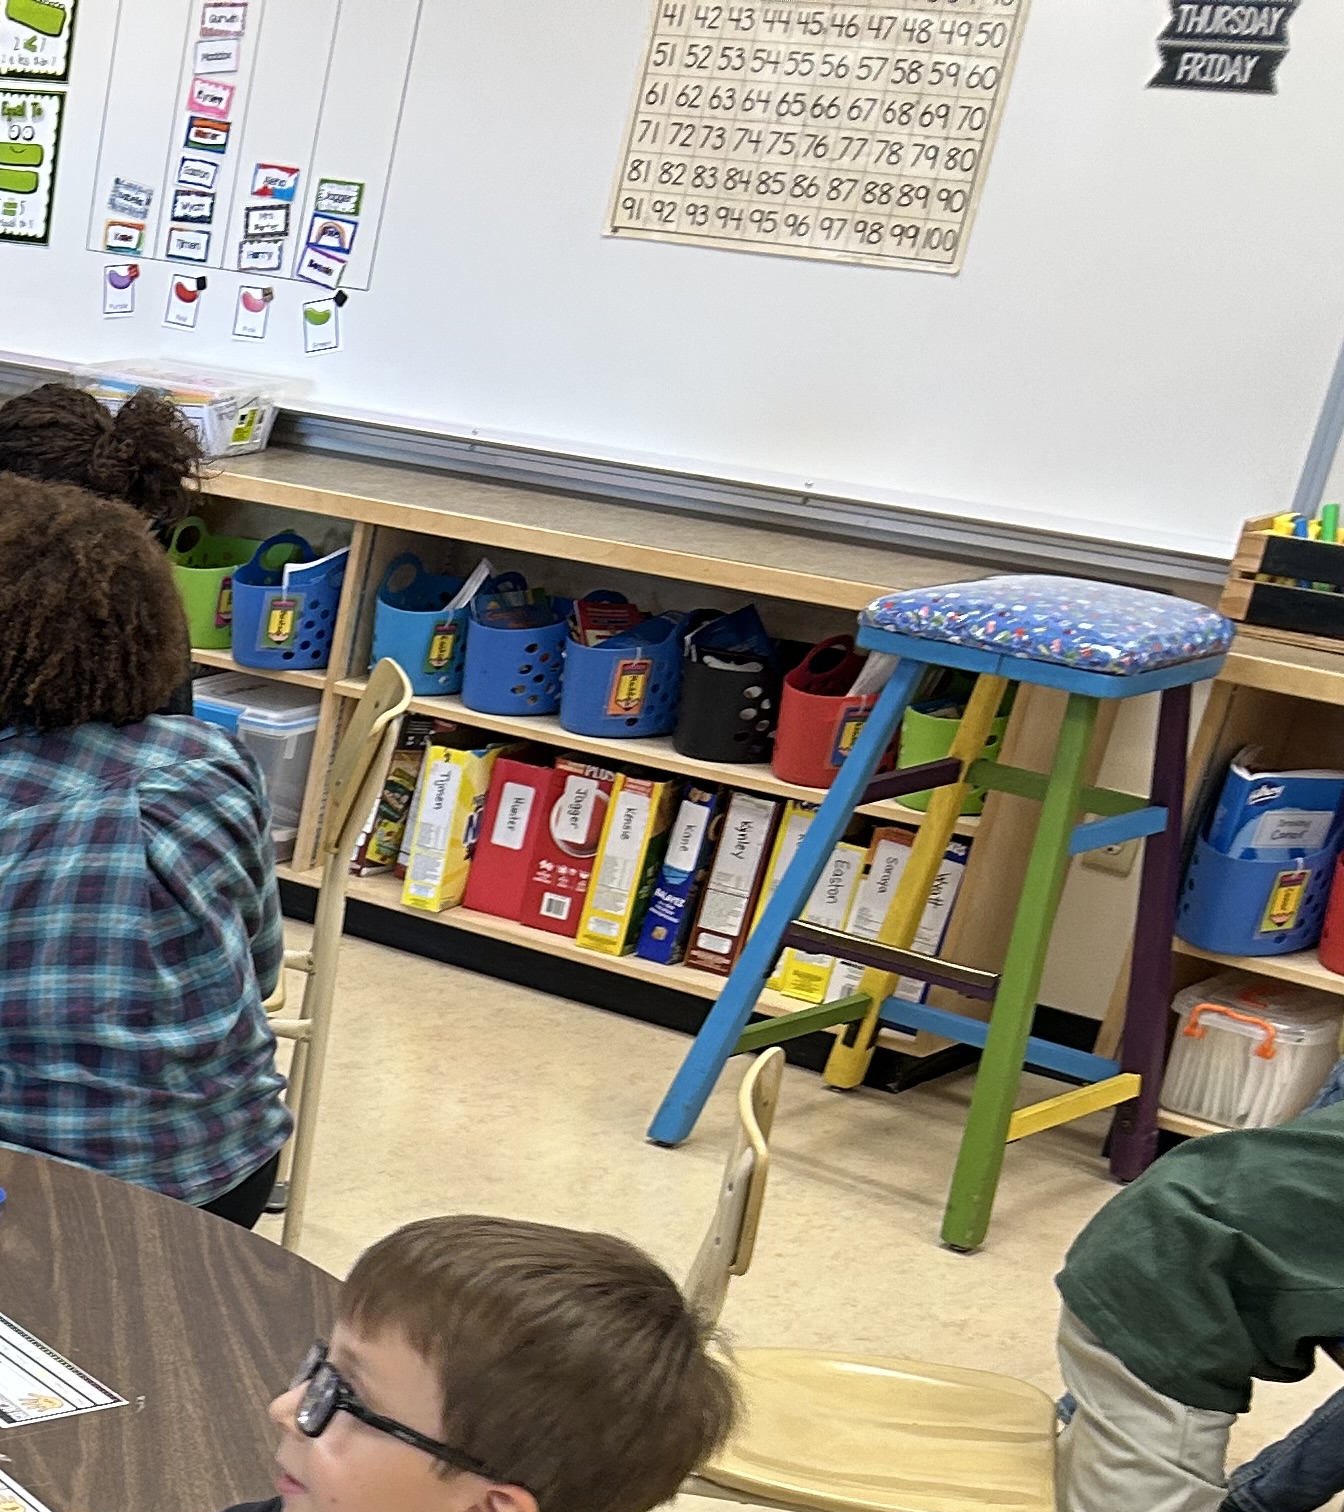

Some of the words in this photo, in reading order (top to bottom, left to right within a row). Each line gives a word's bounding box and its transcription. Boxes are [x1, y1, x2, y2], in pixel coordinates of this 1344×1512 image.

[663, 3, 686, 27] 41
[694, 5, 722, 29] 42
[728, 6, 755, 31] 43
[763, 8, 792, 33] 44
[796, 11, 824, 36] 45
[830, 13, 860, 39] 46
[867, 15, 898, 40] 47
[903, 17, 934, 44] 48
[939, 18, 972, 46] 49
[975, 22, 1007, 48] 50
[1175, 4, 1286, 36] THURSDAY
[653, 42, 677, 67] 51
[683, 44, 713, 69] 52
[718, 46, 745, 71] 53
[750, 49, 780, 74] 54
[784, 51, 815, 76] 55
[819, 53, 849, 79] 56
[855, 56, 889, 82] 57
[890, 58, 925, 85] 58
[927, 60, 961, 87] 59
[965, 64, 1000, 90] 60
[1174, 52, 1261, 84] FRIDAY
[645, 82, 669, 106] 61
[675, 83, 703, 109] 62
[708, 86, 736, 111] 63
[741, 88, 772, 113] 64
[775, 92, 807, 117] 65
[810, 94, 841, 120] 66
[847, 97, 879, 122] 67
[882, 100, 915, 126] 68
[918, 103, 951, 130] 69
[957, 105, 986, 131] 70
[637, 120, 660, 144] 71
[668, 122, 696, 147] 72
[699, 125, 726, 150] 73
[732, 127, 763, 153] 74
[766, 131, 799, 155] 75
[802, 134, 829, 158] 76
[838, 136, 869, 162] 77
[874, 140, 904, 165] 78
[911, 143, 940, 170] 79
[944, 147, 976, 172] 80
[627, 158, 652, 183] 81
[658, 161, 687, 186] 82
[691, 164, 719, 189] 83
[723, 167, 753, 193] 84
[755, 170, 788, 195] 85
[789, 174, 820, 198] 86
[826, 177, 859, 202] 87
[862, 181, 895, 205] 88
[895, 183, 930, 209] 89
[937, 188, 967, 213] 90
[622, 196, 644, 221] 91
[651, 199, 678, 223] 92
[685, 202, 709, 226] 93
[715, 206, 744, 231] 94
[749, 209, 779, 233] 95
[783, 213, 811, 237] 96
[820, 217, 848, 241] 97
[854, 220, 884, 245] 98
[889, 223, 921, 248] 99
[922, 227, 958, 251] 100
[566, 788, 589, 830] Jagger
[730, 820, 755, 860] Kynley
